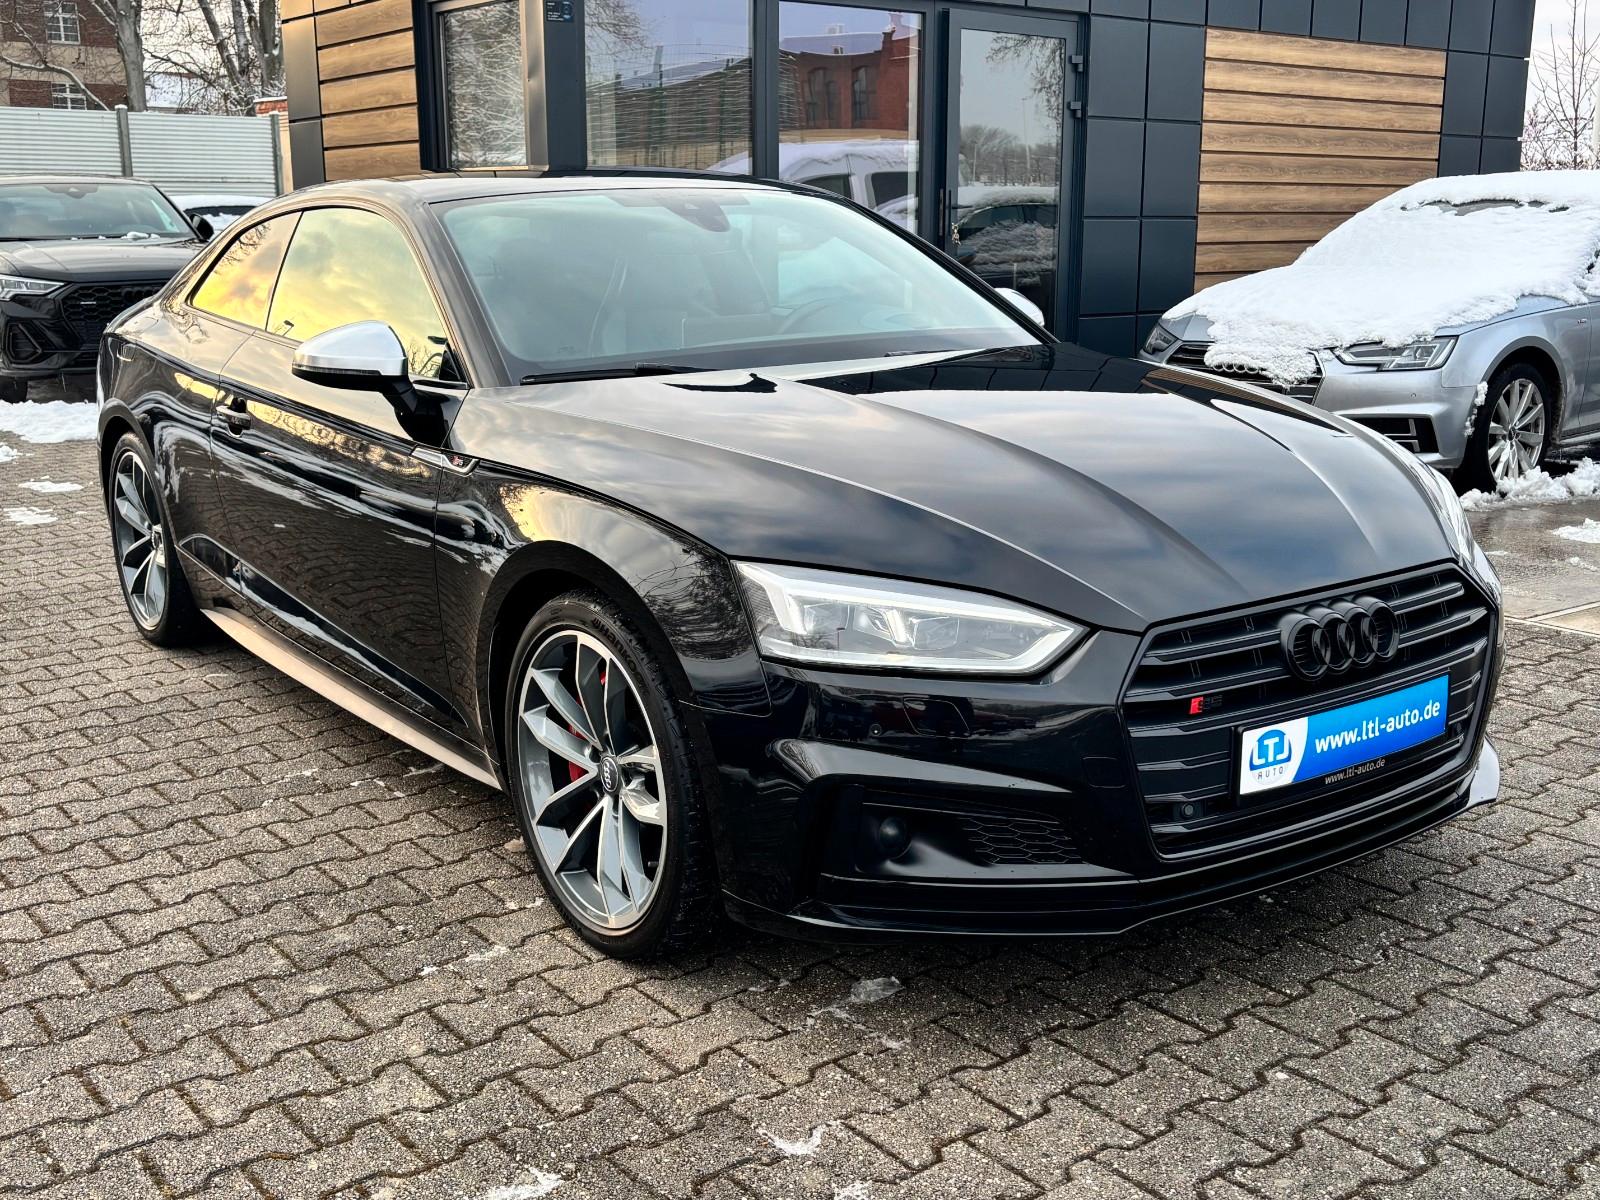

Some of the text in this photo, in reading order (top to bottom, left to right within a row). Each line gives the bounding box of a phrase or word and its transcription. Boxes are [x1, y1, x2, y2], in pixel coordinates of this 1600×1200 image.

[1315, 699, 1441, 754] www.ltl-auto.de
[1257, 766, 1284, 780] AUTO
[1324, 757, 1386, 785] www.ltl-auto.de
